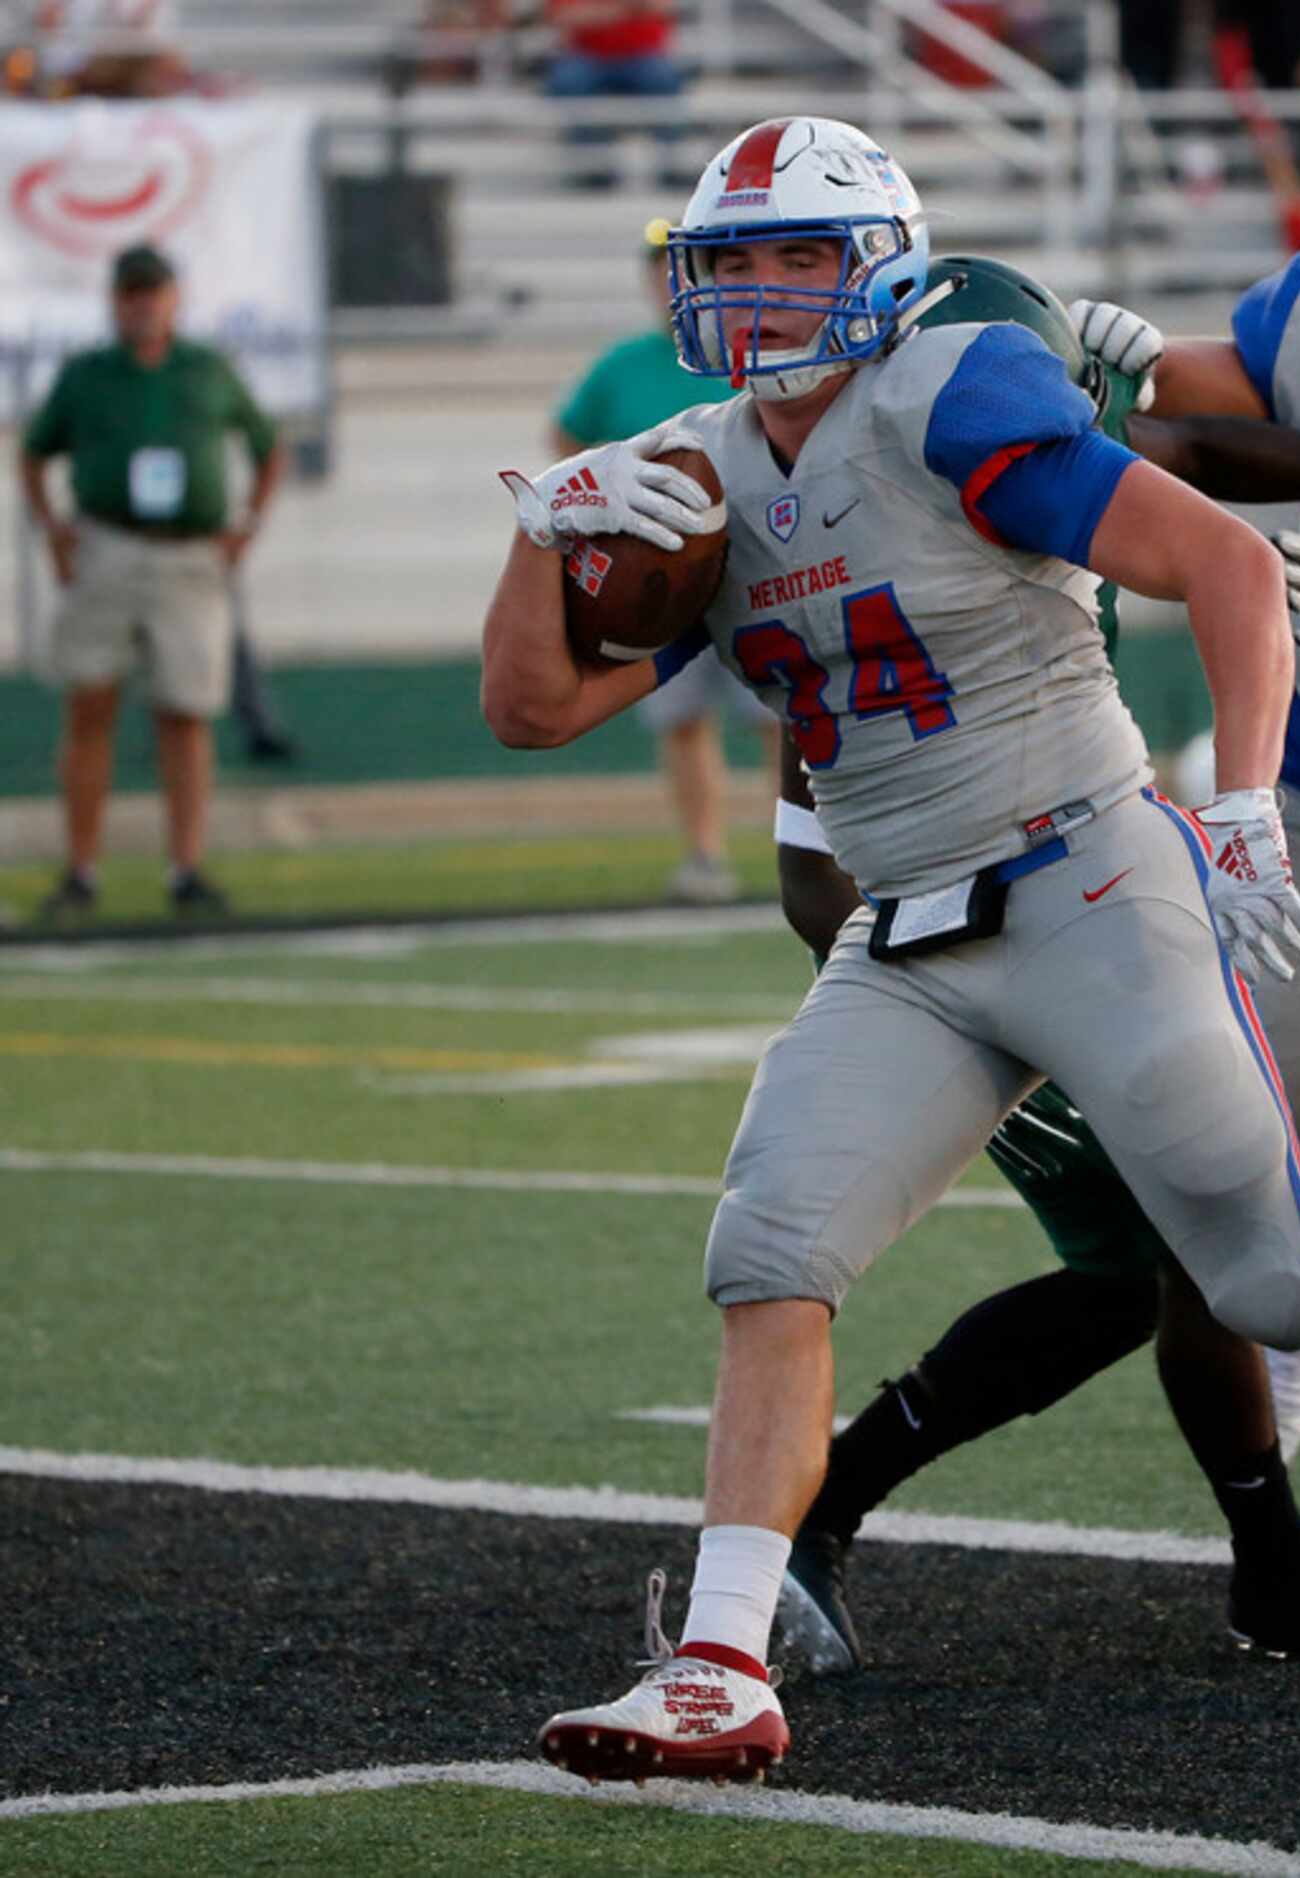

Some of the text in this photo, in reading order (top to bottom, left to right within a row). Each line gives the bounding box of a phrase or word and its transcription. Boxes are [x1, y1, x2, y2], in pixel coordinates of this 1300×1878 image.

[550, 491, 609, 512] adidas
[748, 555, 852, 612] HERITAGE
[732, 580, 959, 770] 34
